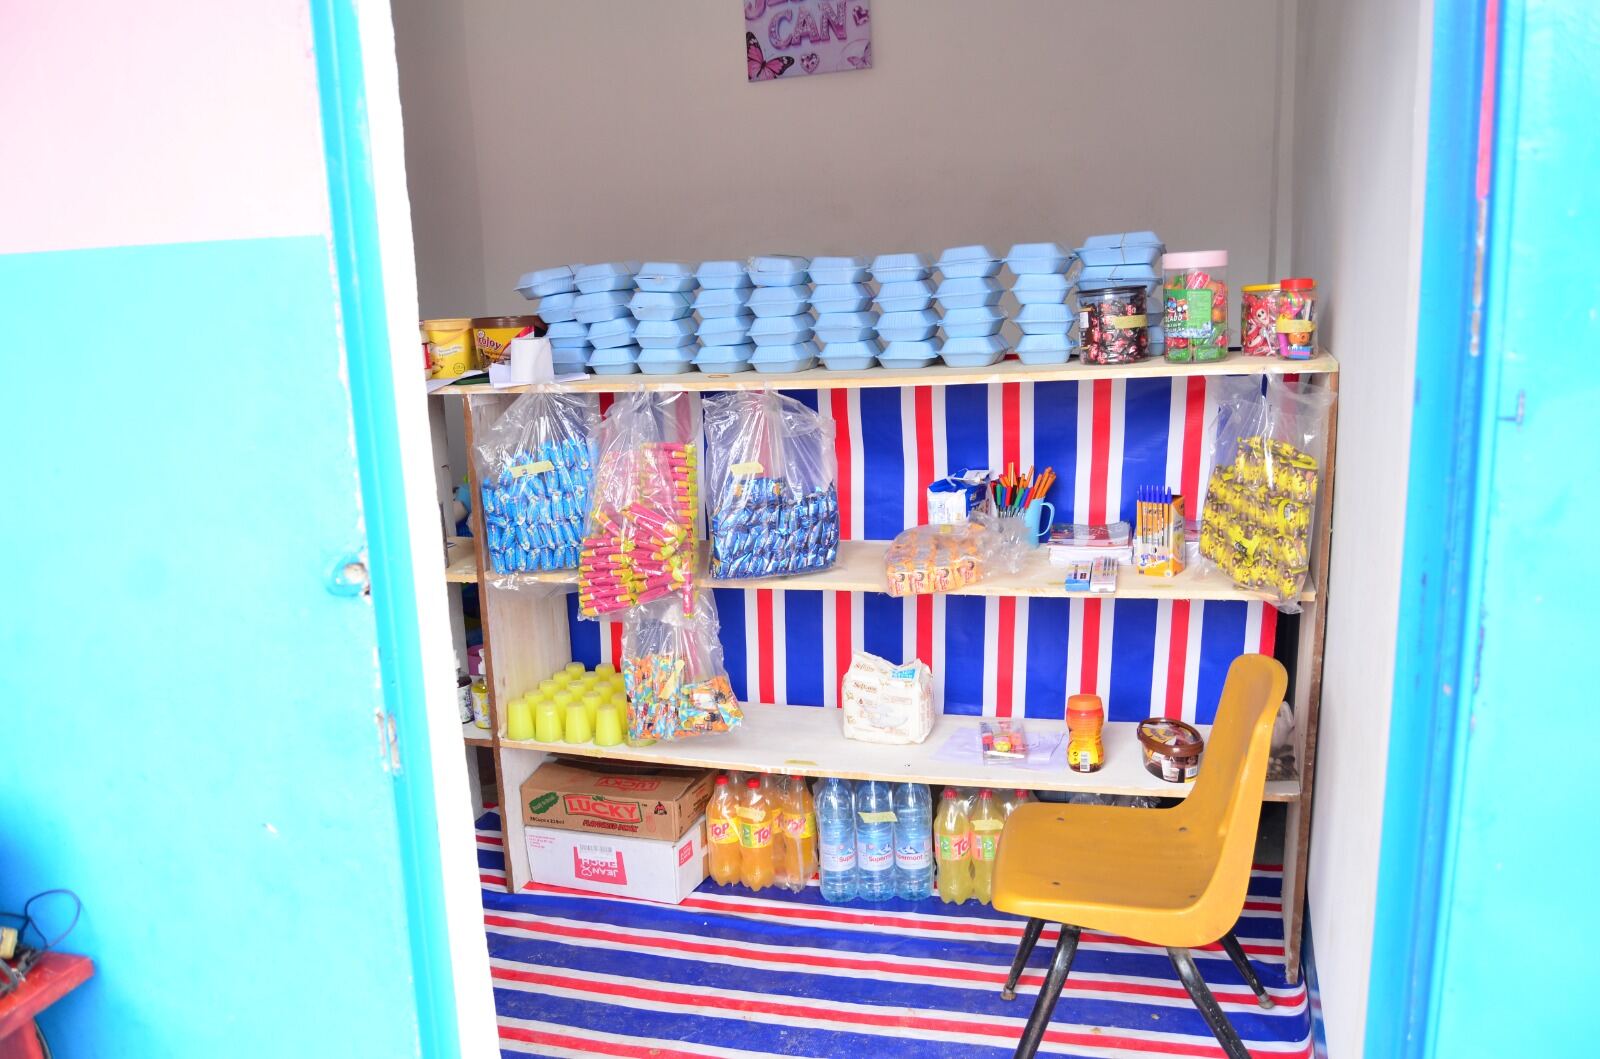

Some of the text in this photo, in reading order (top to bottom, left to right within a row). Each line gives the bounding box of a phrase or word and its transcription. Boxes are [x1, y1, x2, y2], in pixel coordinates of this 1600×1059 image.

[768, 1, 847, 50] CAN
[567, 799, 637, 819] LUCKY
[592, 867, 618, 877] JEAN
